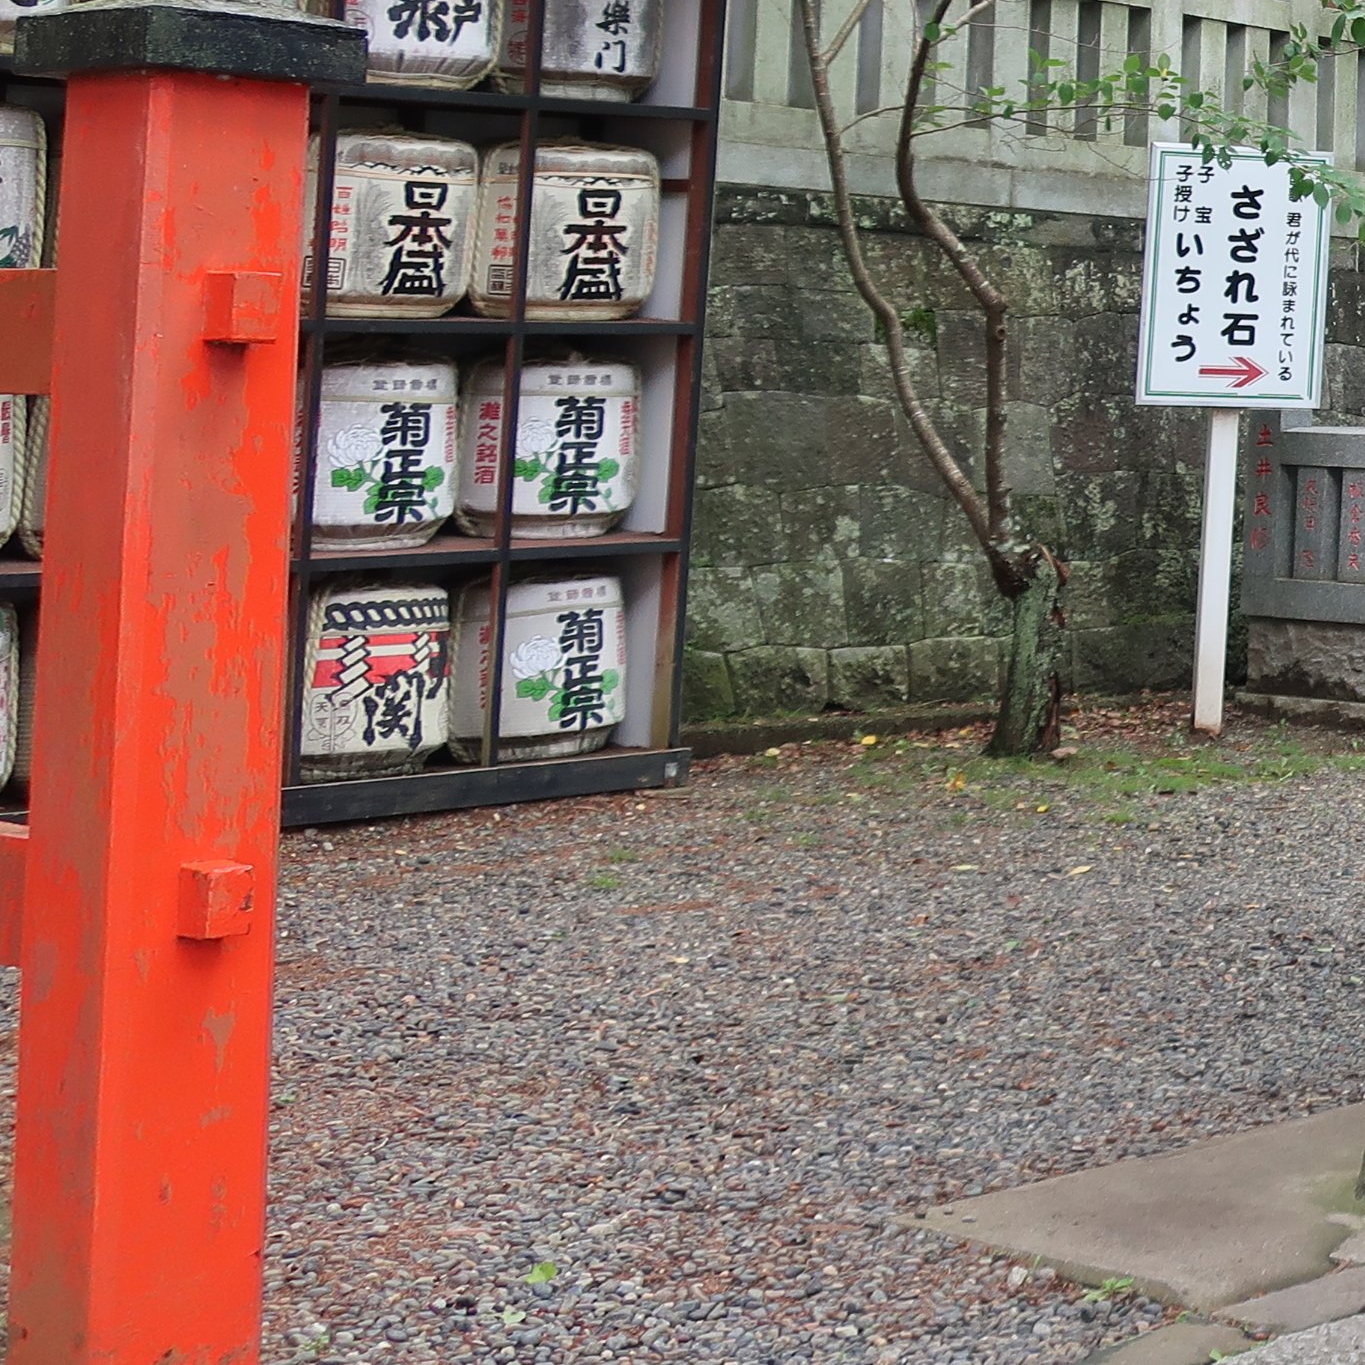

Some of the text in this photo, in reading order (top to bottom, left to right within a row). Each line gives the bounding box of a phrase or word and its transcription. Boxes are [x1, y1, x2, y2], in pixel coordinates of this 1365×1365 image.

[383, 180, 453, 297] 日本盛
[561, 188, 629, 301] 日本盛
[1173, 164, 1194, 223] 子授け
[1171, 232, 1204, 363] いちょう
[1220, 185, 1266, 347] さざれ石
[1278, 212, 1302, 382] 君が代に詠まれている
[374, 401, 433, 524] 菊正宗
[548, 395, 607, 515] 菊正宗
[557, 607, 605, 731] 菊正宗
